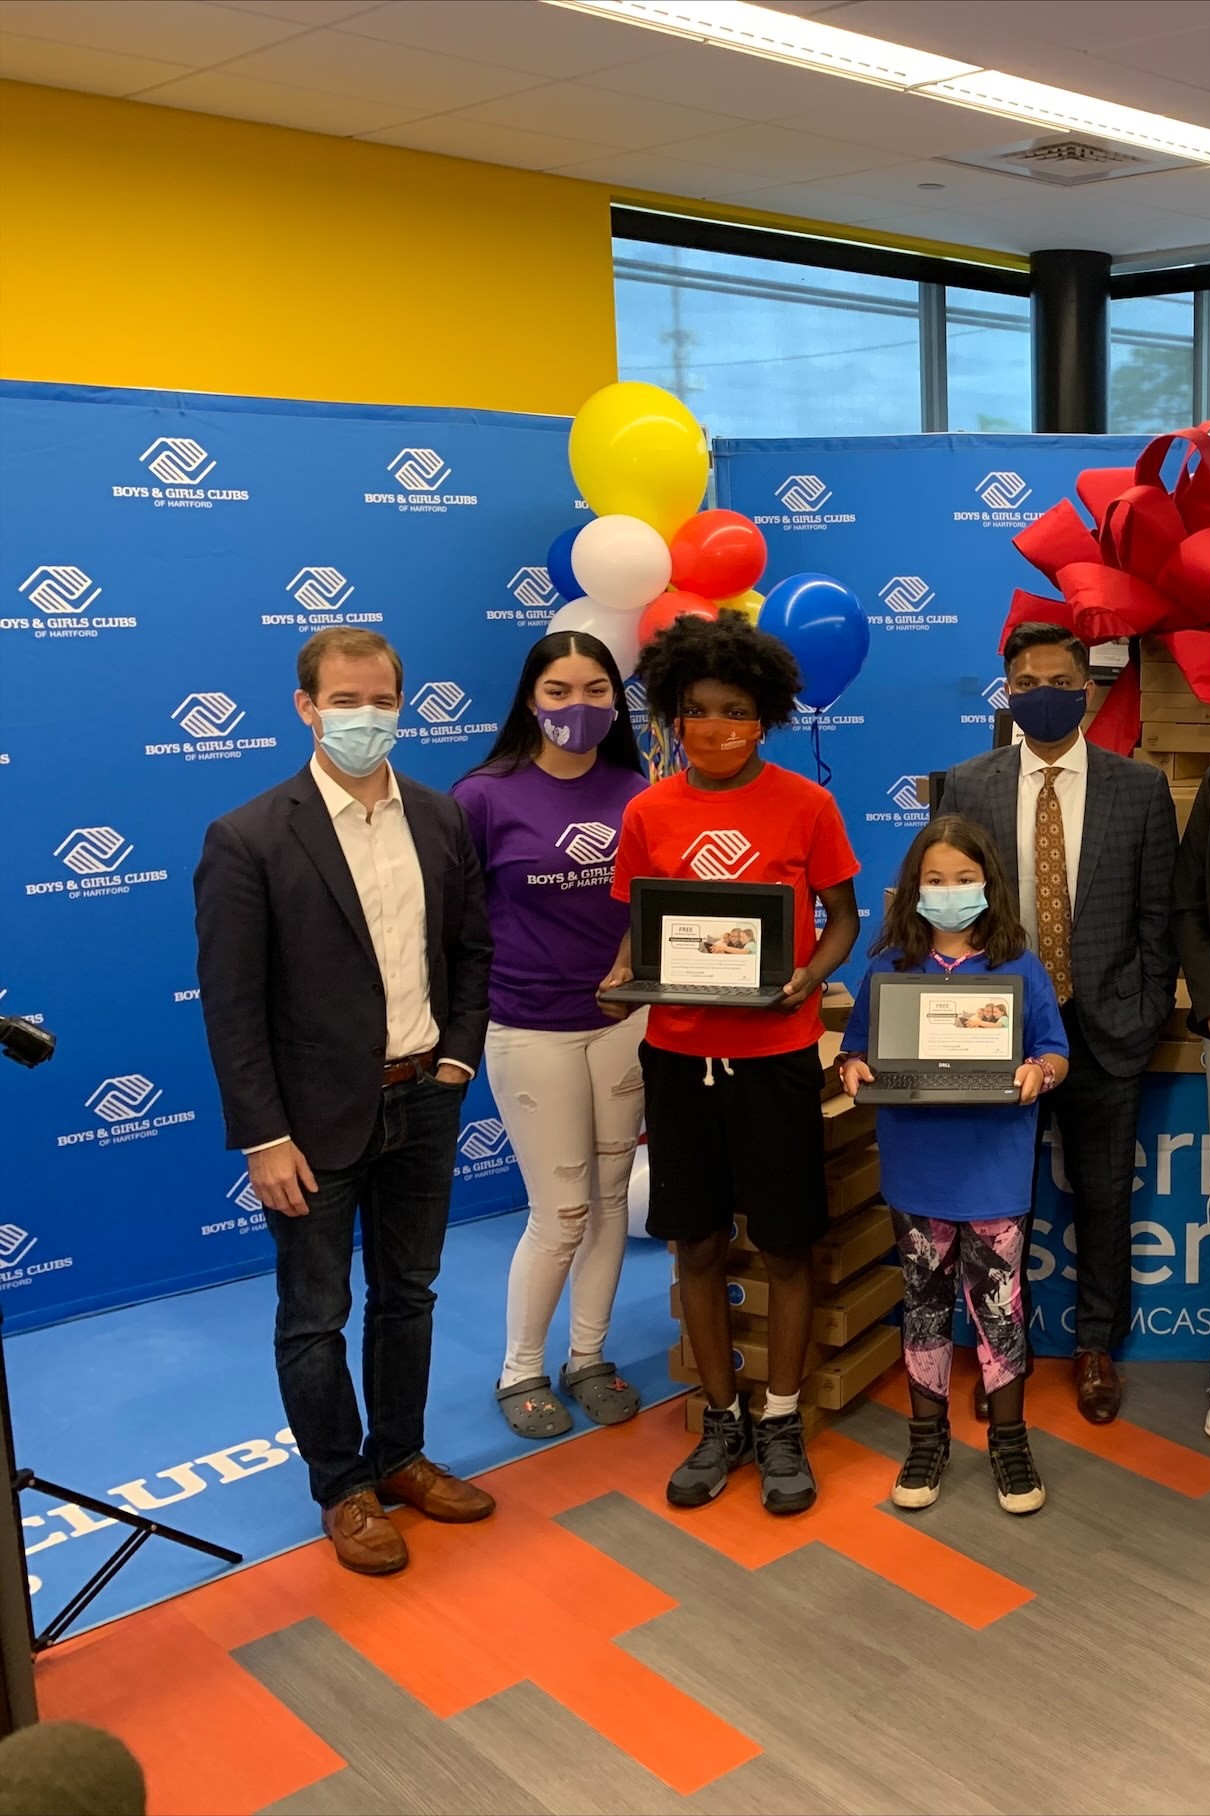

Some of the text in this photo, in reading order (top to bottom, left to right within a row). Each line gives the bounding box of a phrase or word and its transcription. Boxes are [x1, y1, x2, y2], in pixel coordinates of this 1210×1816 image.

[112, 486, 249, 500] BOYS & GIRLS CLUBS
[364, 494, 477, 505] BOYS & GIRLS CLUBS
[575, 500, 589, 509] BO
[754, 514, 856, 524] BOYS & GIRLS CLUBS
[954, 512, 979, 520] BOYS
[982, 512, 990, 520] &
[992, 512, 1021, 520] GIRLS
[261, 613, 383, 624] BOYS & GIRLS CLUBS
[487, 610, 555, 620] BOYS & GIRLS
[885, 616, 893, 624] &
[895, 616, 924, 624] GIRLS
[926, 615, 958, 623] CLUBS
[0, 617, 136, 629] OYS & GIRLS CLUBS
[50, 630, 98, 638] HARTFORD
[833, 716, 864, 724] CLUBS
[961, 715, 986, 723] BOYS
[397, 724, 498, 738] OYS & GIRLS CLUBS
[145, 738, 277, 755] BOYS & GIRLS CLUBS
[185, 751, 242, 761] OF HARTFORD
[893, 813, 901, 821] &
[26, 869, 167, 895] BOYS & GIRLS CLUBS
[527, 873, 564, 885] BOYS
[568, 872, 578, 881] &
[561, 882, 574, 890] OF
[68, 886, 130, 899] OF HARTFORD
[174, 989, 200, 1002] BOY
[57, 1111, 195, 1147] BOYS & GIRLS CLUBS
[99, 1129, 158, 1147] OF HARTFORD
[462, 1165, 471, 1173] &
[473, 1157, 504, 1172] GIRLS
[474, 1166, 509, 1179] HARTFORD
[201, 1220, 235, 1235] BOYS
[237, 1218, 248, 1227] &
[27, 1257, 73, 1275] CLUBS
